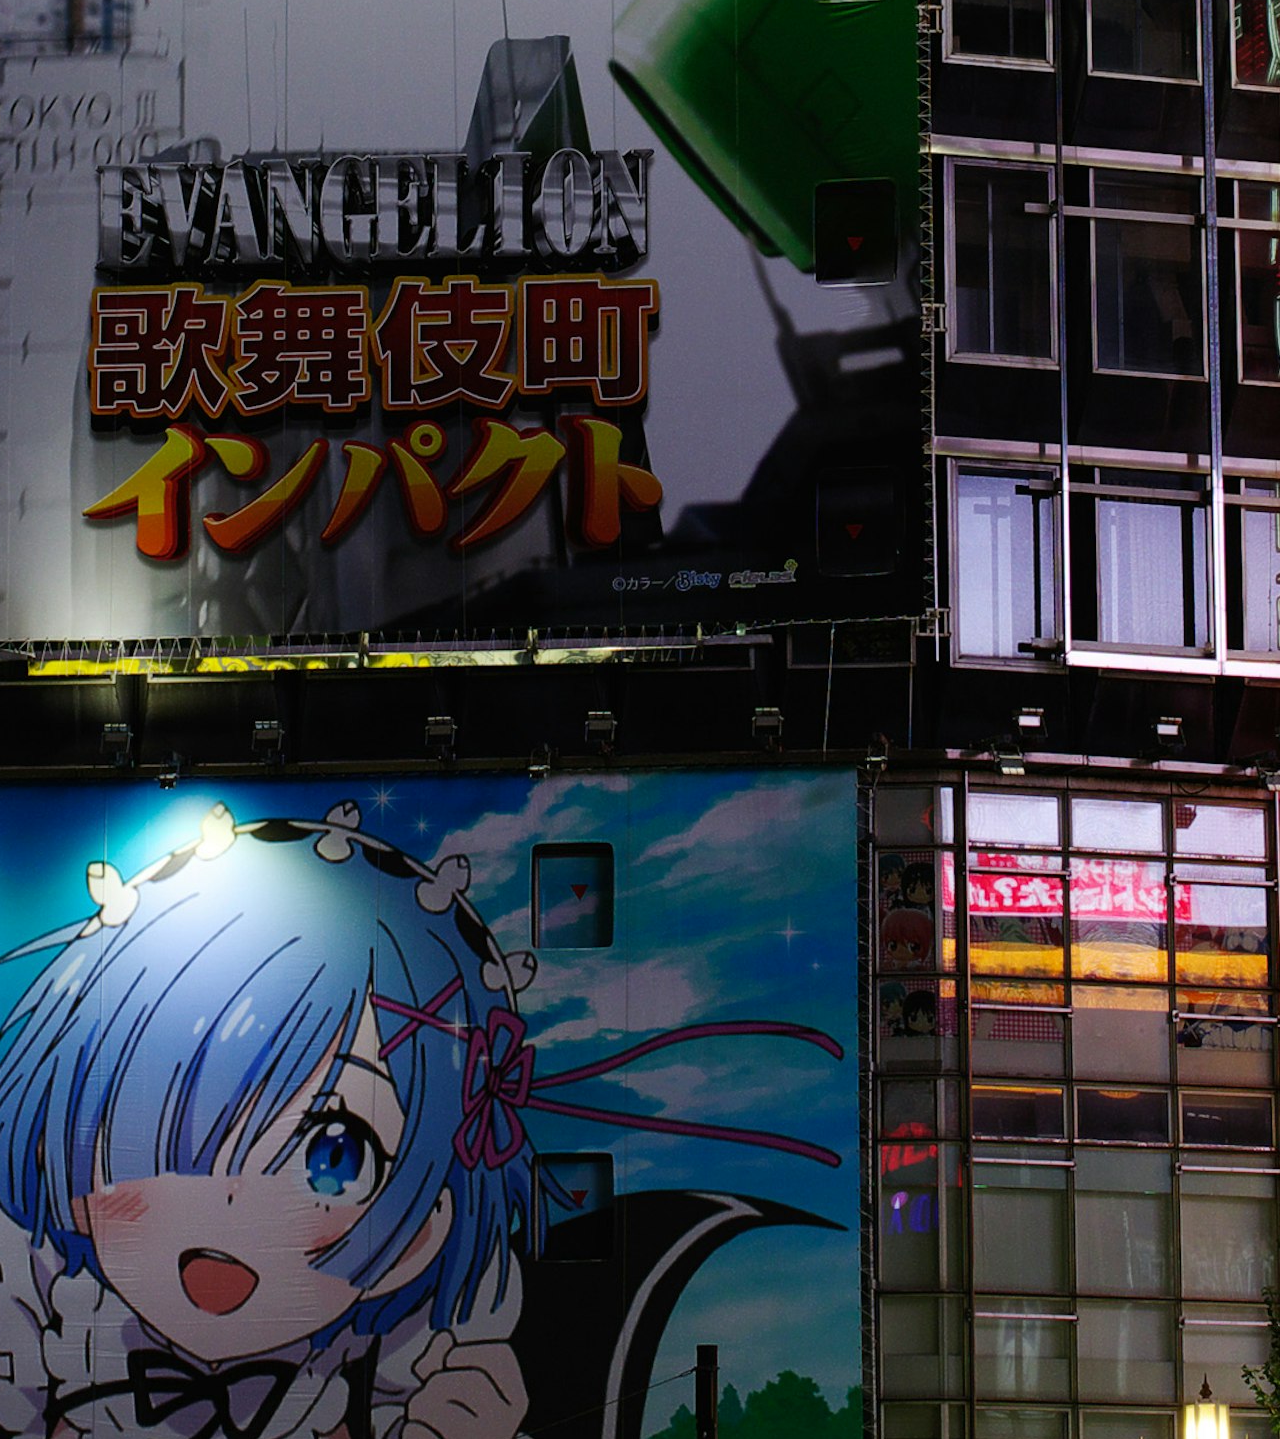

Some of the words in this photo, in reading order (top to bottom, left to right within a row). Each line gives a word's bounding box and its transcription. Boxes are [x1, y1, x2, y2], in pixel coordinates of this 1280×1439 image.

[95, 147, 657, 274] EVANGELION
[90, 276, 660, 419] 歌舞伎町
[82, 417, 663, 561] インパクト
